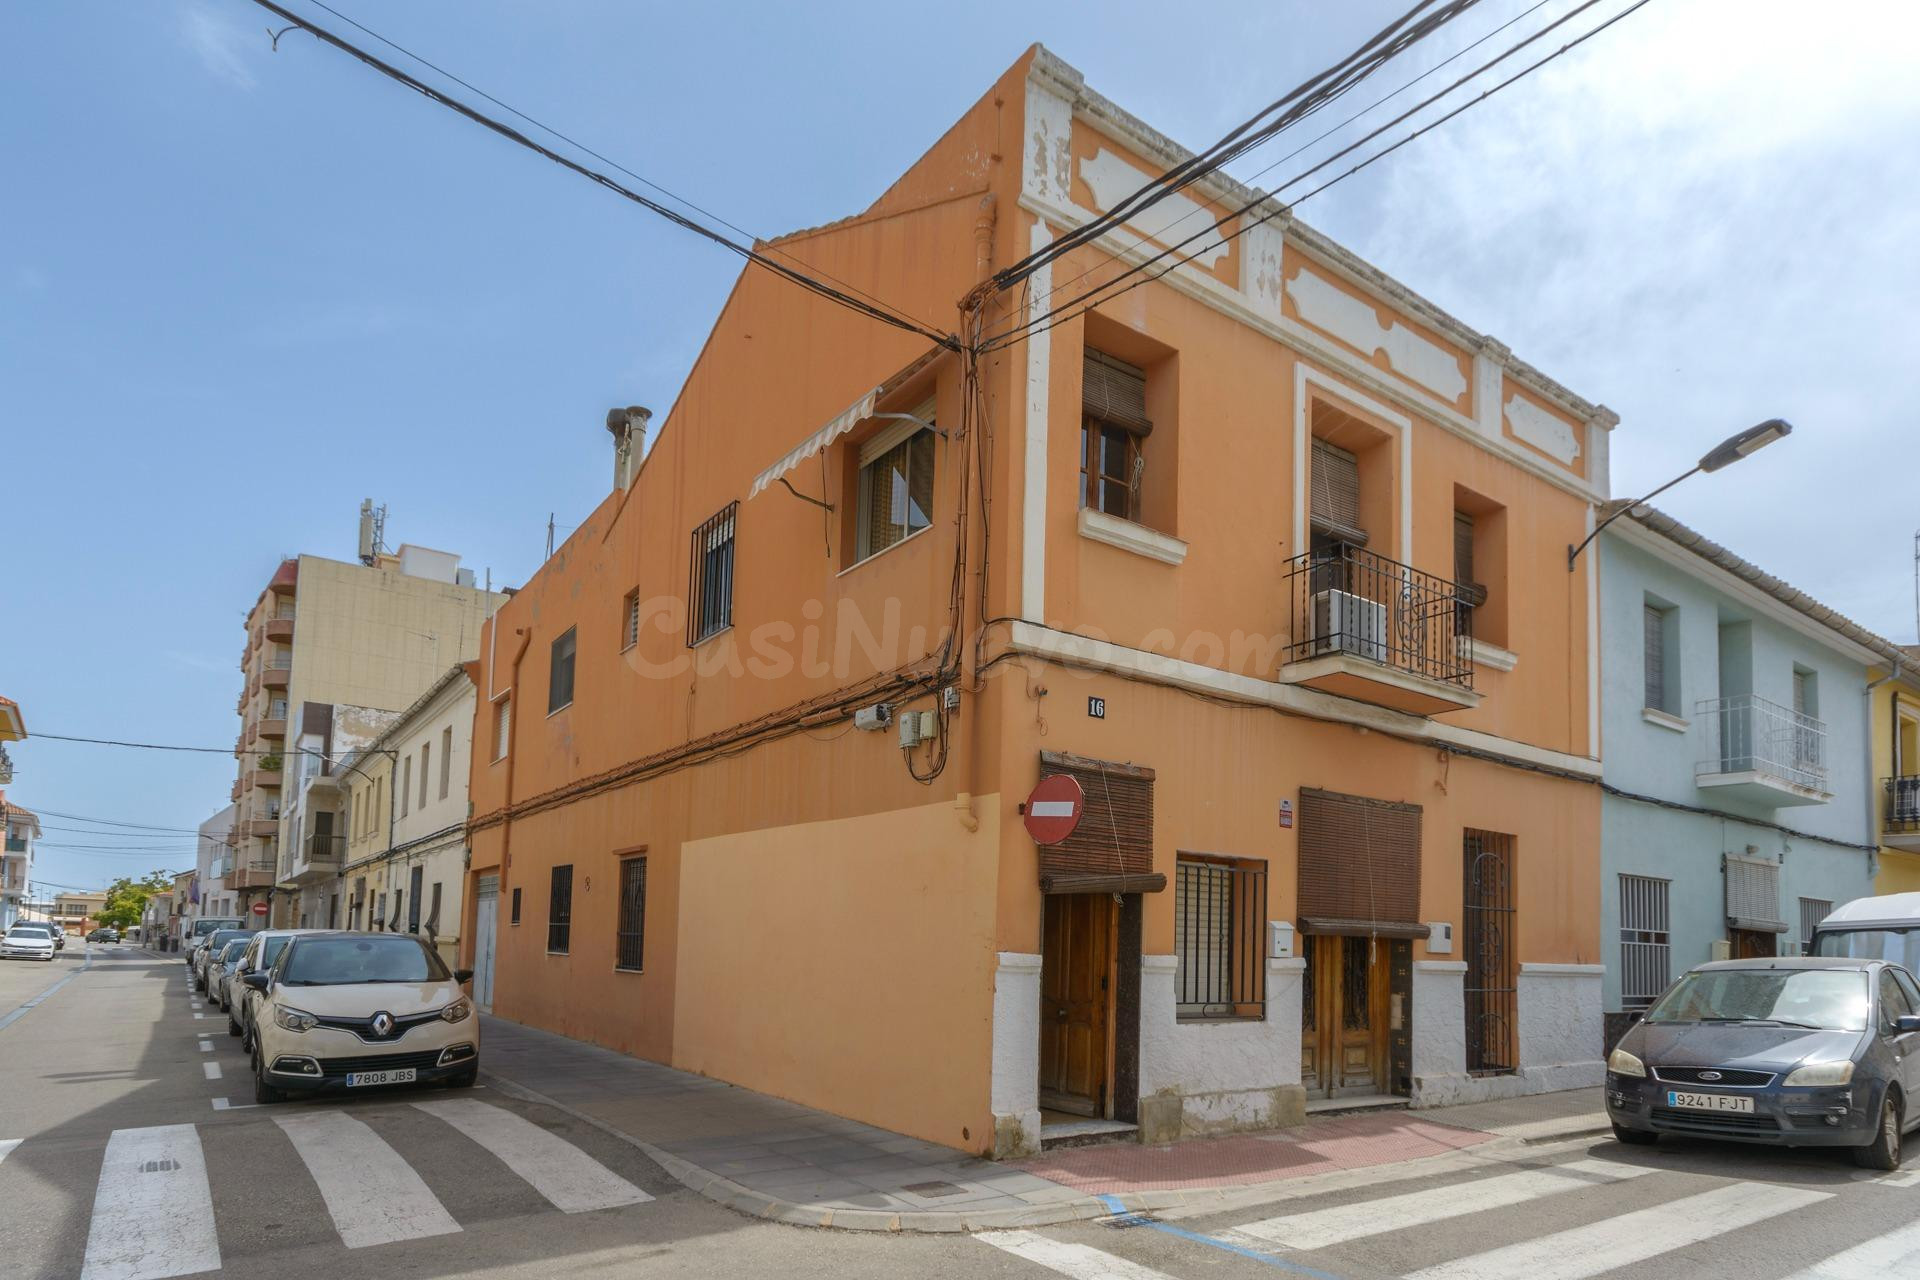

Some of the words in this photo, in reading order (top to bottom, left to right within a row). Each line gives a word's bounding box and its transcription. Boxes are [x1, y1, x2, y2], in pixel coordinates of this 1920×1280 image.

[1090, 699, 1104, 717] 16
[355, 1072, 387, 1084] 7808
[391, 1070, 413, 1082] JBS
[1677, 1094, 1712, 1108] 9241
[1719, 1097, 1748, 1110] FJT
